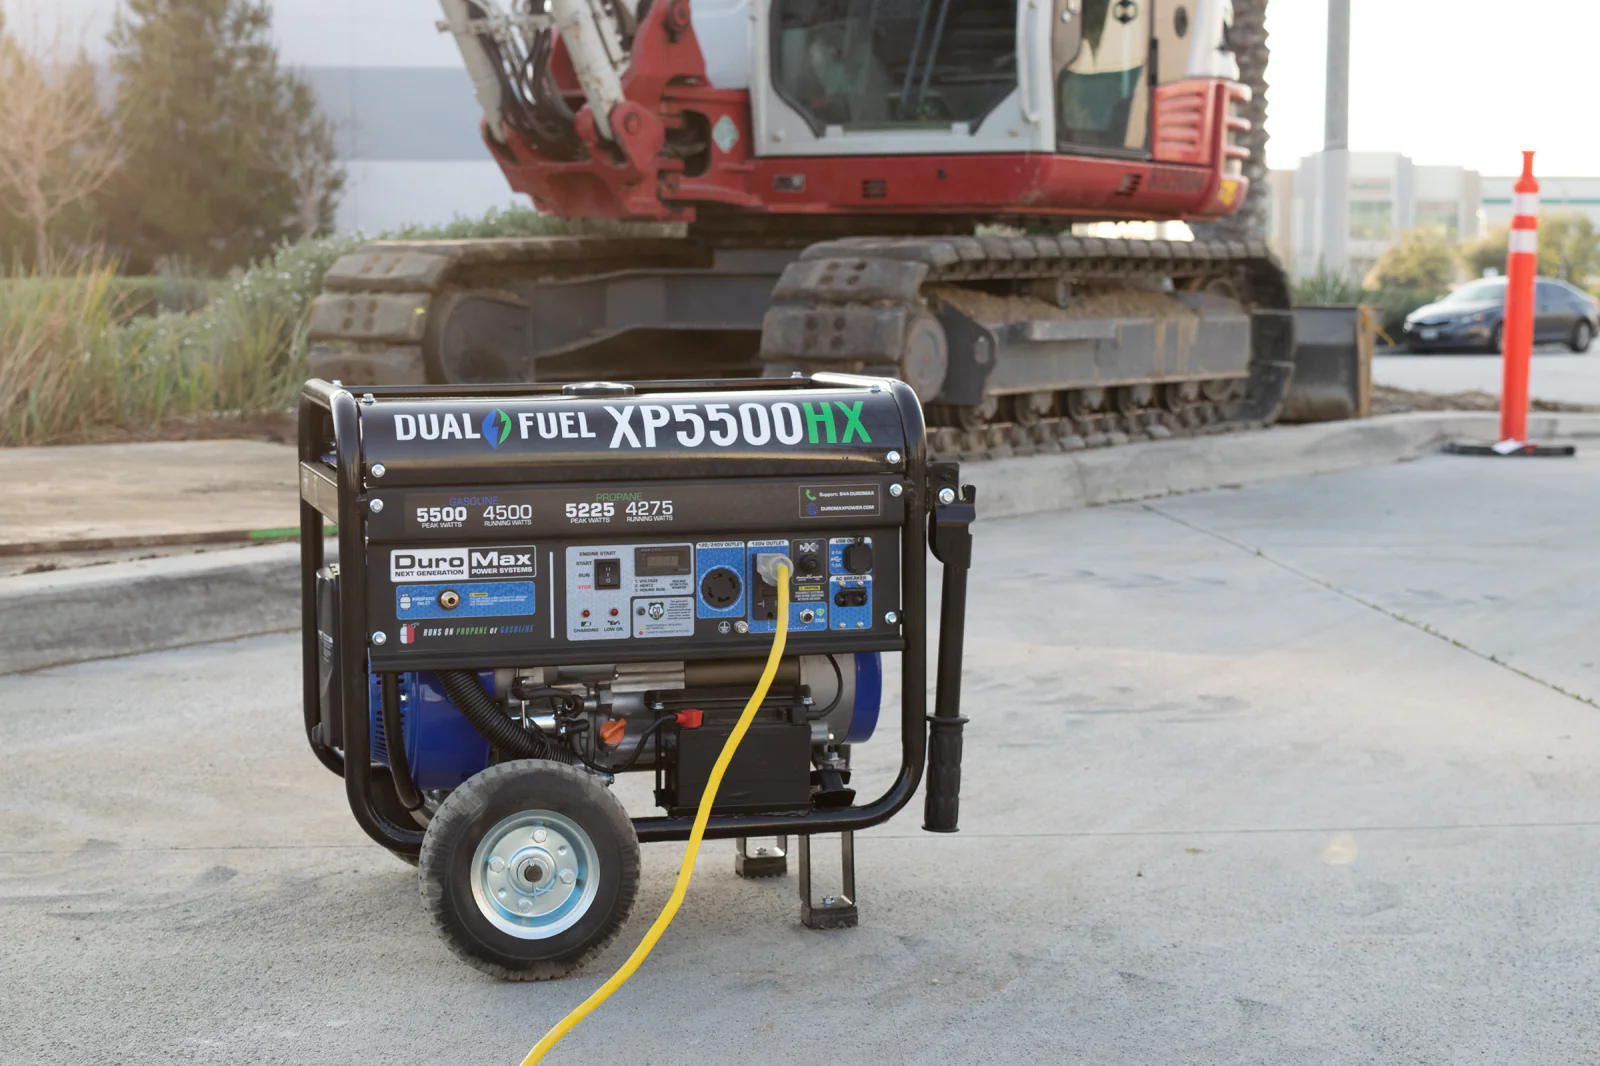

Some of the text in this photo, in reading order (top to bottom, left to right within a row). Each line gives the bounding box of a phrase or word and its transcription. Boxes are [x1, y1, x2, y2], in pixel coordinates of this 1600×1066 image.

[394, 401, 872, 449] DUAL FUEL XP5500HX
[450, 496, 498, 506] GASOLINE
[596, 492, 642, 501] PROPANE
[416, 504, 532, 522] 5500 4500
[566, 500, 673, 518] 5225 4275
[395, 551, 532, 570] Duro Max
[423, 628, 442, 636] RUNS
[456, 627, 488, 635] PROPANE
[500, 625, 534, 633] GASOLINE
